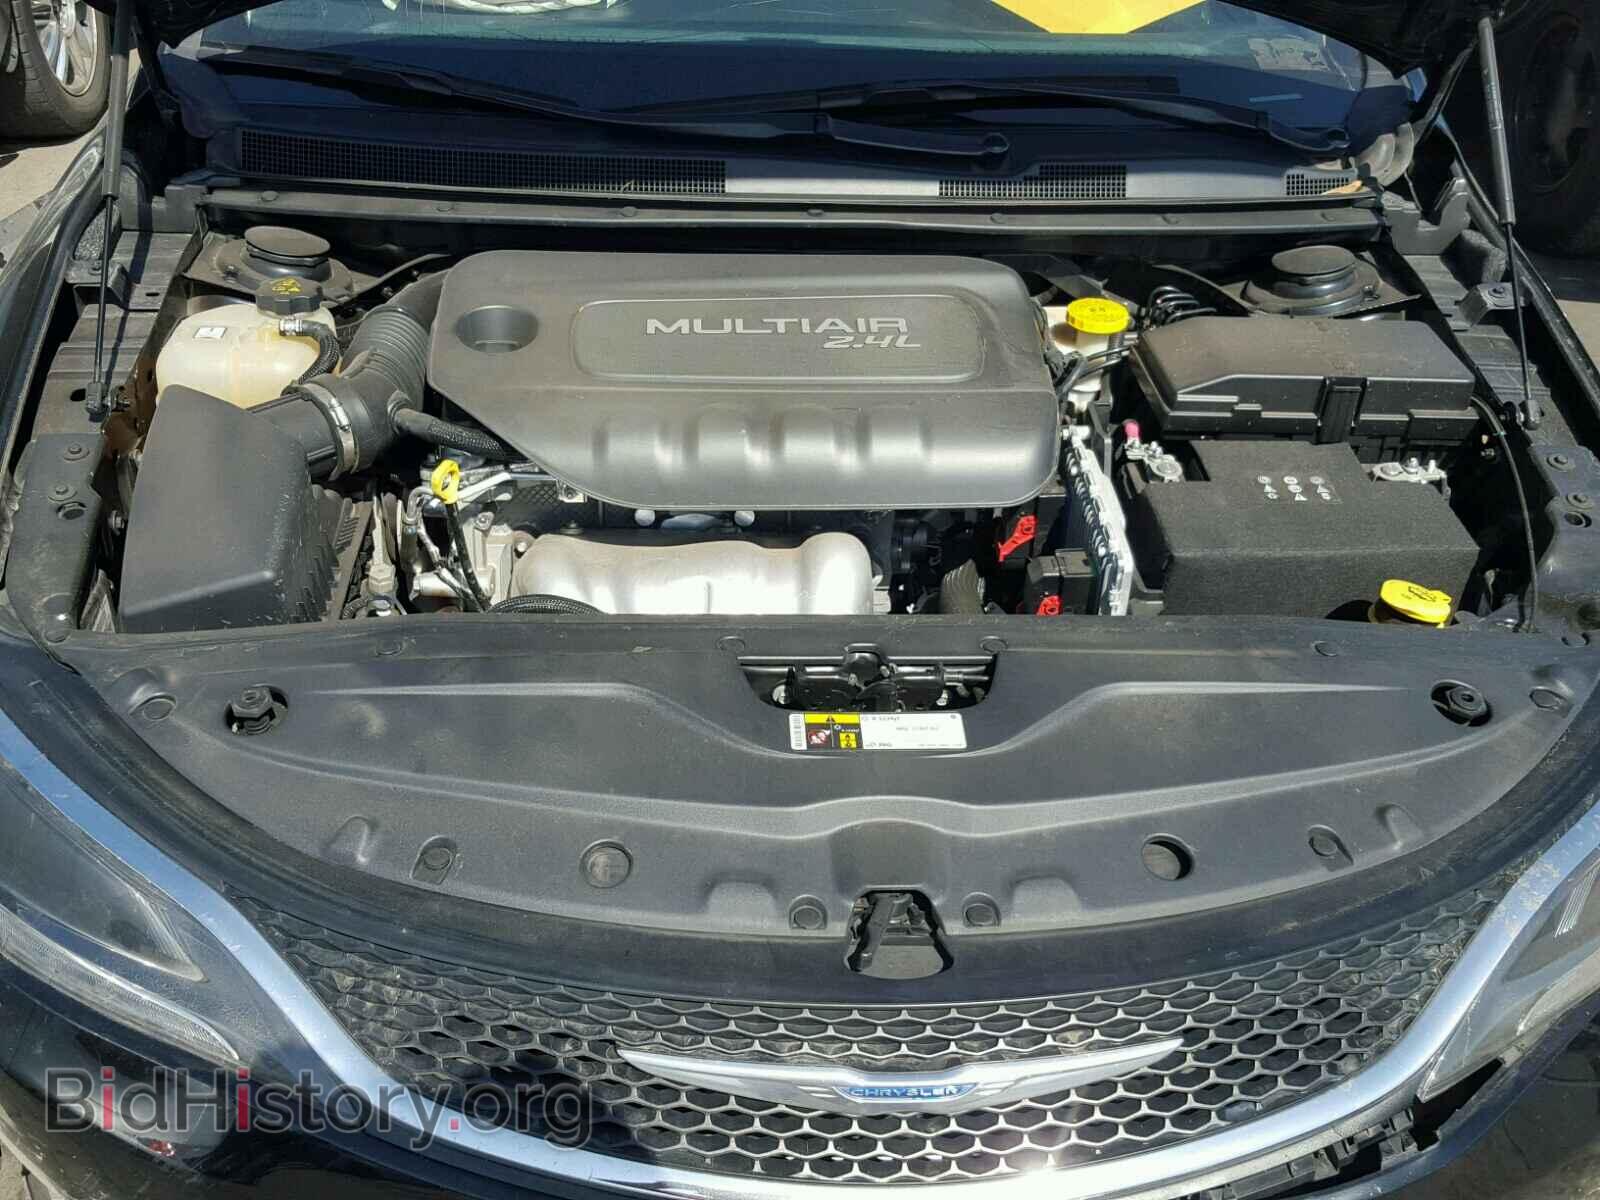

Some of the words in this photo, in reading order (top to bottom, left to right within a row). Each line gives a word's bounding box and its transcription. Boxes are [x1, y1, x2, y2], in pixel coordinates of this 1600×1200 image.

[646, 318, 908, 334] MULTIAIR
[824, 335, 921, 350] 2.4L
[851, 1085, 958, 1098] CHRYSLER
